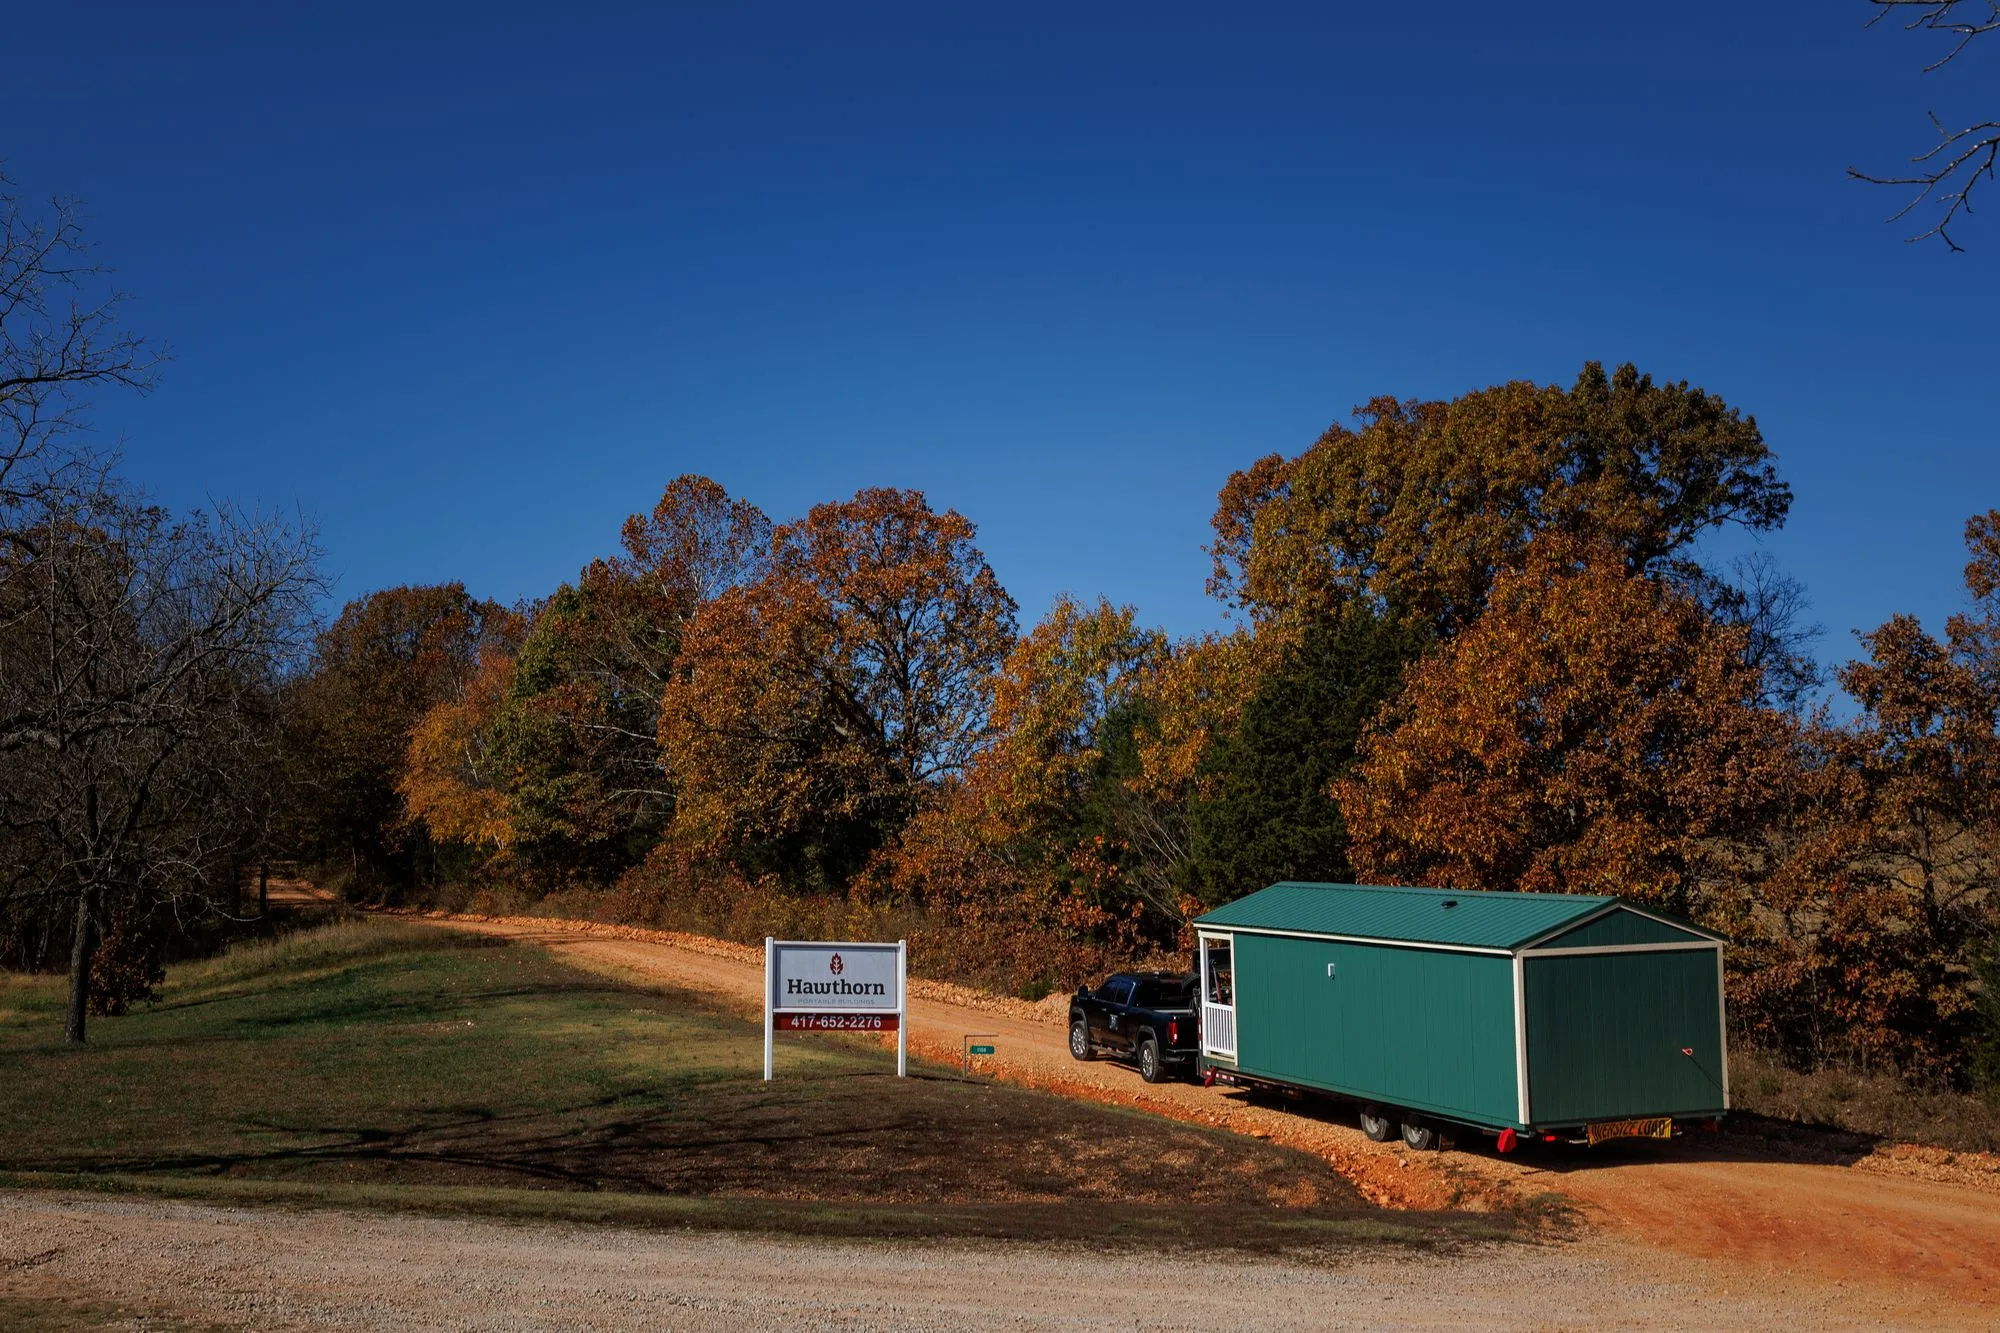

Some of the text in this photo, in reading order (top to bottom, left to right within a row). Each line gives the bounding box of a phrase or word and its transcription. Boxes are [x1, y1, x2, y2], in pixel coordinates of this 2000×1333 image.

[787, 979, 885, 995] Hawthorn
[791, 1016, 881, 1028] 417-652-2276
[1637, 1120, 1665, 1136] LOAD
